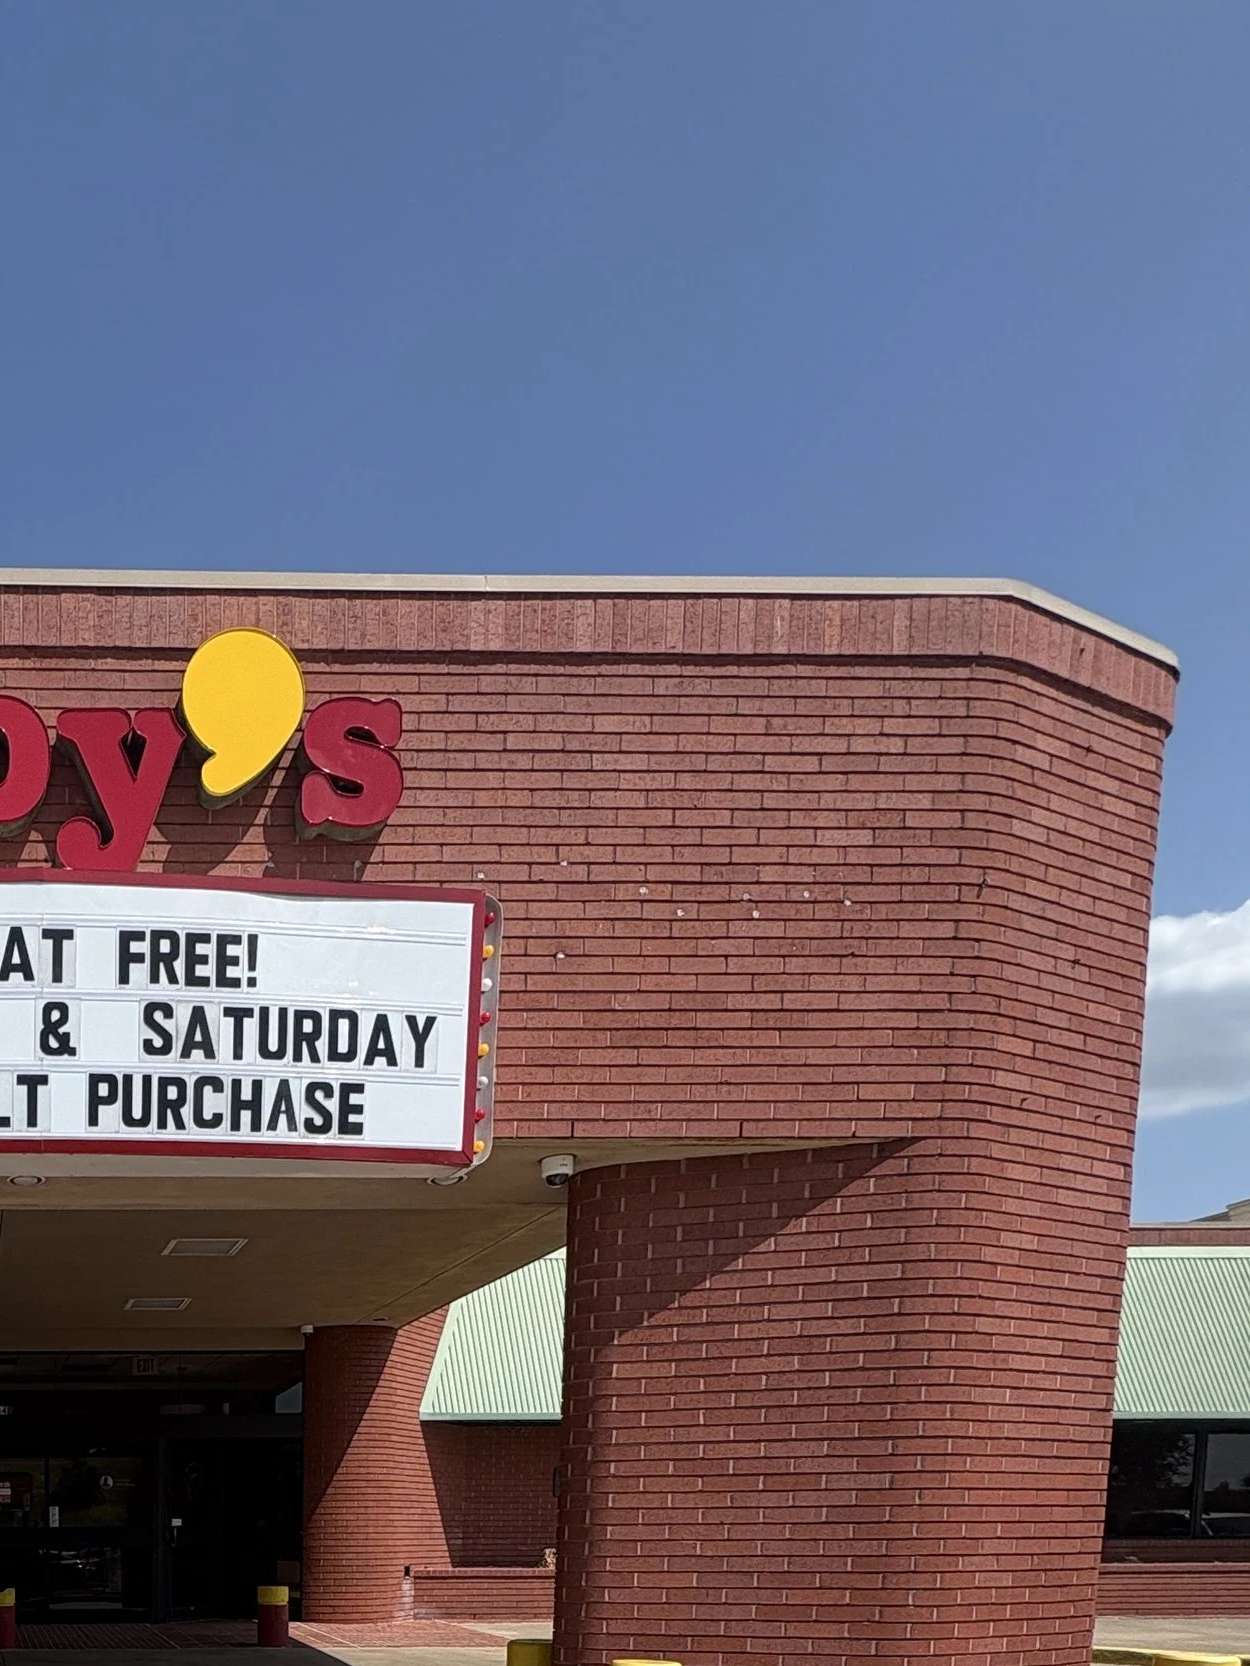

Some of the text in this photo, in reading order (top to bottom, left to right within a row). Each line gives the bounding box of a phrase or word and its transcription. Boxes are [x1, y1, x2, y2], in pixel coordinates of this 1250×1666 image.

[118, 929, 259, 989] FREE!
[39, 1001, 77, 1057] &
[142, 1001, 437, 1068] SATURDAY
[88, 1073, 365, 1136] PURCHASE
